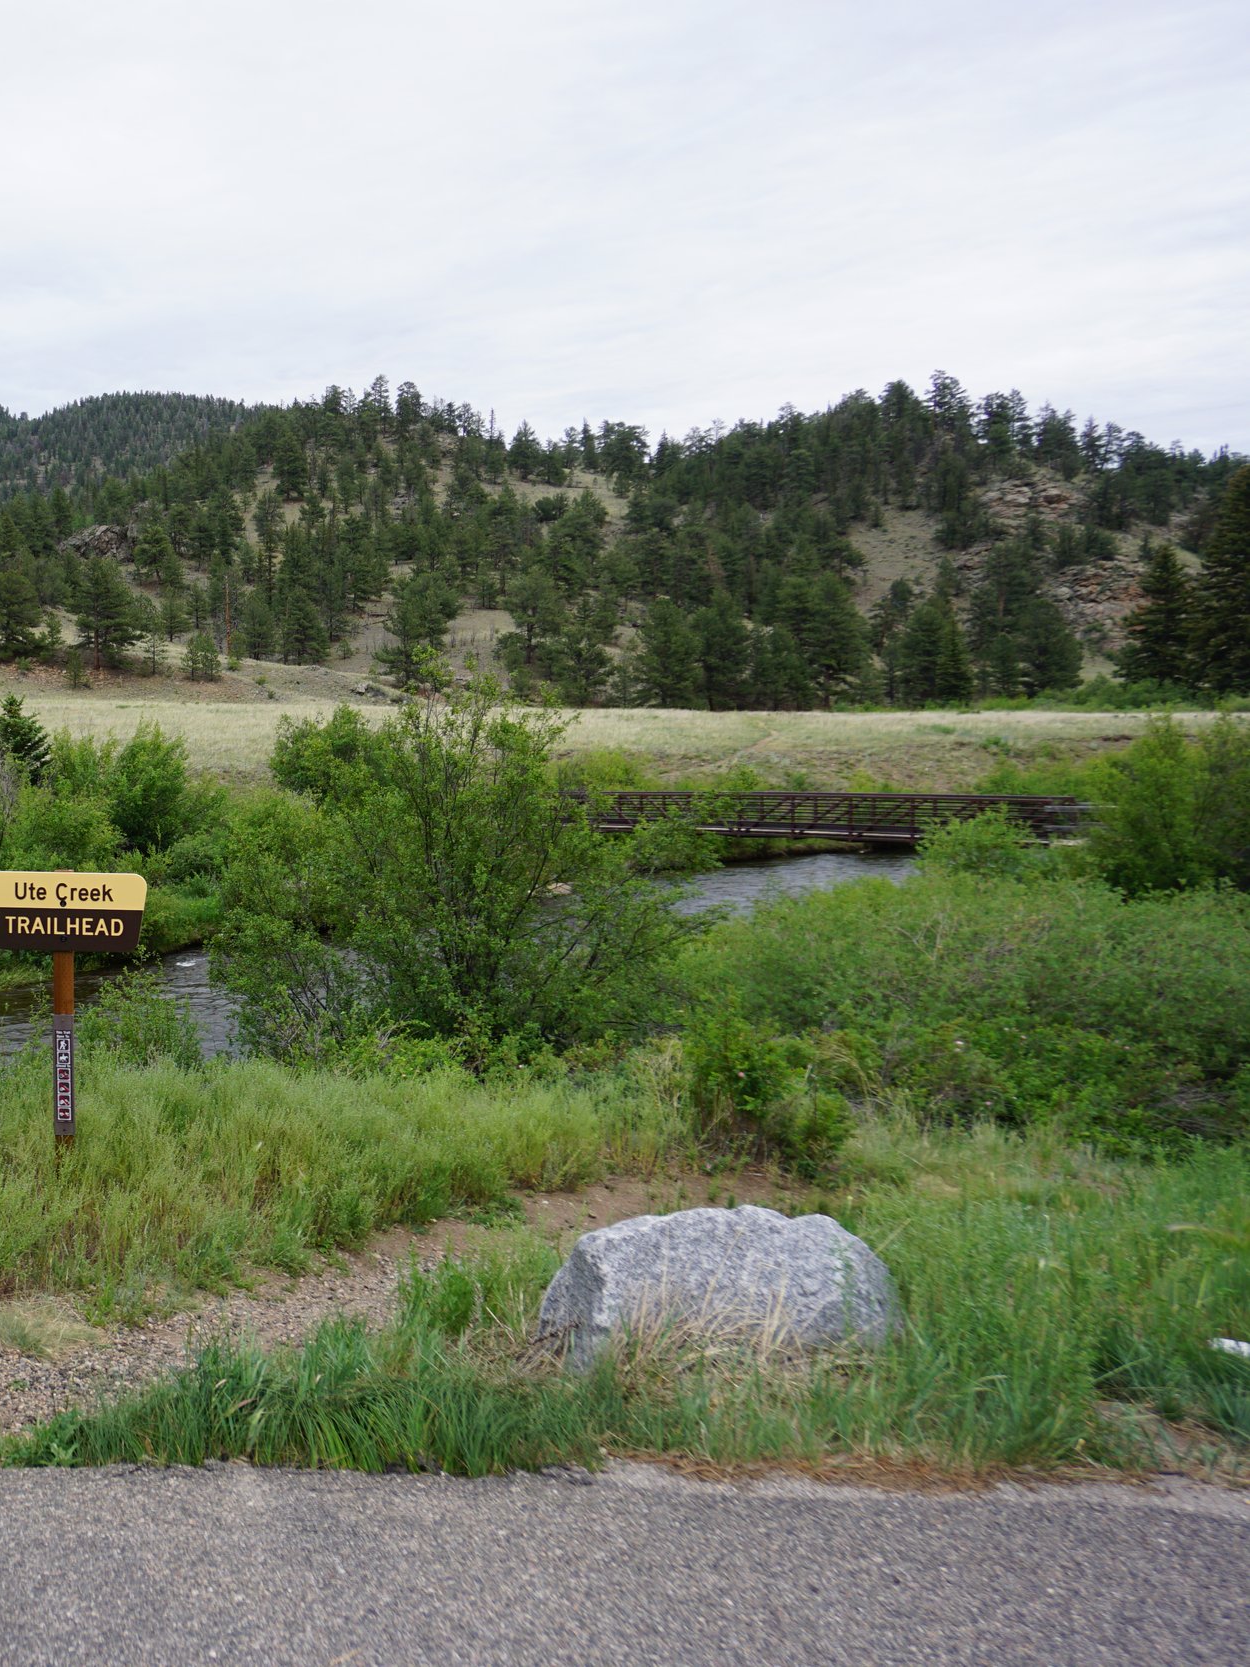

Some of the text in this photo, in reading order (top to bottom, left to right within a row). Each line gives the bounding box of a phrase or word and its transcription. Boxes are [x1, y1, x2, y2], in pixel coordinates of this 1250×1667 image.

[14, 882, 114, 902] Ute Creek
[4, 915, 125, 937] TRAILHEAD
